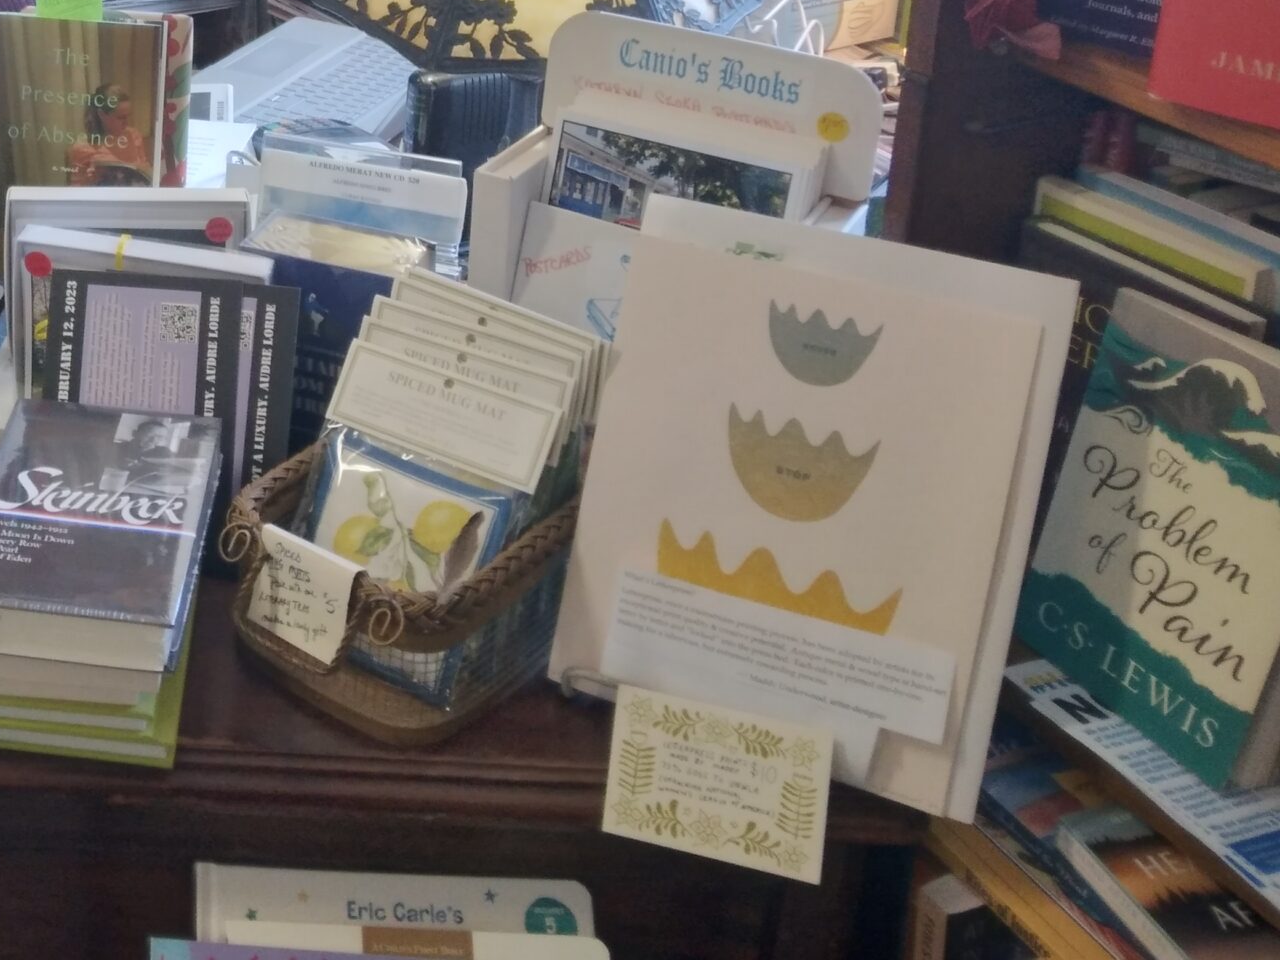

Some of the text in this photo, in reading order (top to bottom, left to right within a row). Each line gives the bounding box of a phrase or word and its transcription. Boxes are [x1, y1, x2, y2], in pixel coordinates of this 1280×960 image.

[1136, 11, 1158, 23] and
[53, 48, 89, 66] The
[619, 38, 804, 105] Canio's Books
[21, 85, 118, 109] Presence
[8, 125, 129, 149] of Absence
[309, 160, 405, 182] ALFREDO MERAT NEW CD
[523, 246, 593, 277] POSTCARDS
[57, 342, 74, 404] BRUARY
[66, 280, 77, 309] 2023
[205, 296, 221, 384] AUDRE LORDE
[253, 303, 277, 463] A LUXURY. AUDRE LORDE
[403, 346, 521, 394] SPICED MUG MAT
[387, 370, 508, 421] SPICED MUG MAT
[1149, 448, 1193, 494] The
[1, 529, 30, 539] Moon
[33, 533, 42, 541] Is
[44, 535, 75, 545] Down
[1084, 445, 1251, 594] Problem
[6, 554, 32, 564] Eden
[19, 540, 43, 549] Row
[1088, 533, 1128, 574] of
[1130, 551, 1246, 683] Pain
[1100, 644, 1219, 748] LEWIS
[347, 900, 464, 925] Eric Carle's
